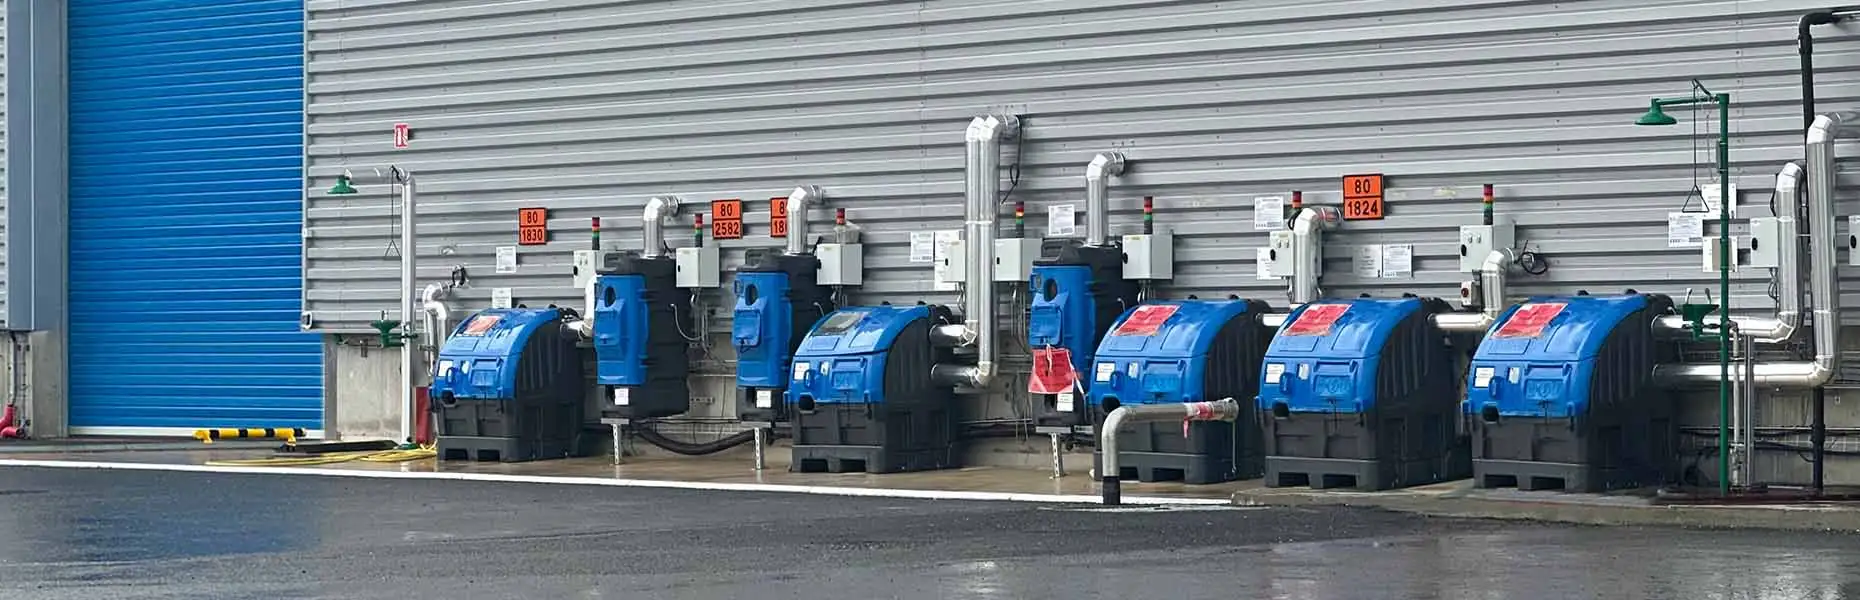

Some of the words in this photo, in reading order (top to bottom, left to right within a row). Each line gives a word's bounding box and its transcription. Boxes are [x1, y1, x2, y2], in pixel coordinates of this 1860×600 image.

[1354, 179, 1370, 194] 80
[720, 203, 732, 216] 80
[1347, 200, 1378, 216] 1824
[527, 212, 538, 224] 80
[715, 221, 739, 236] 2582
[774, 220, 787, 233] 18
[522, 229, 543, 241] 1830
